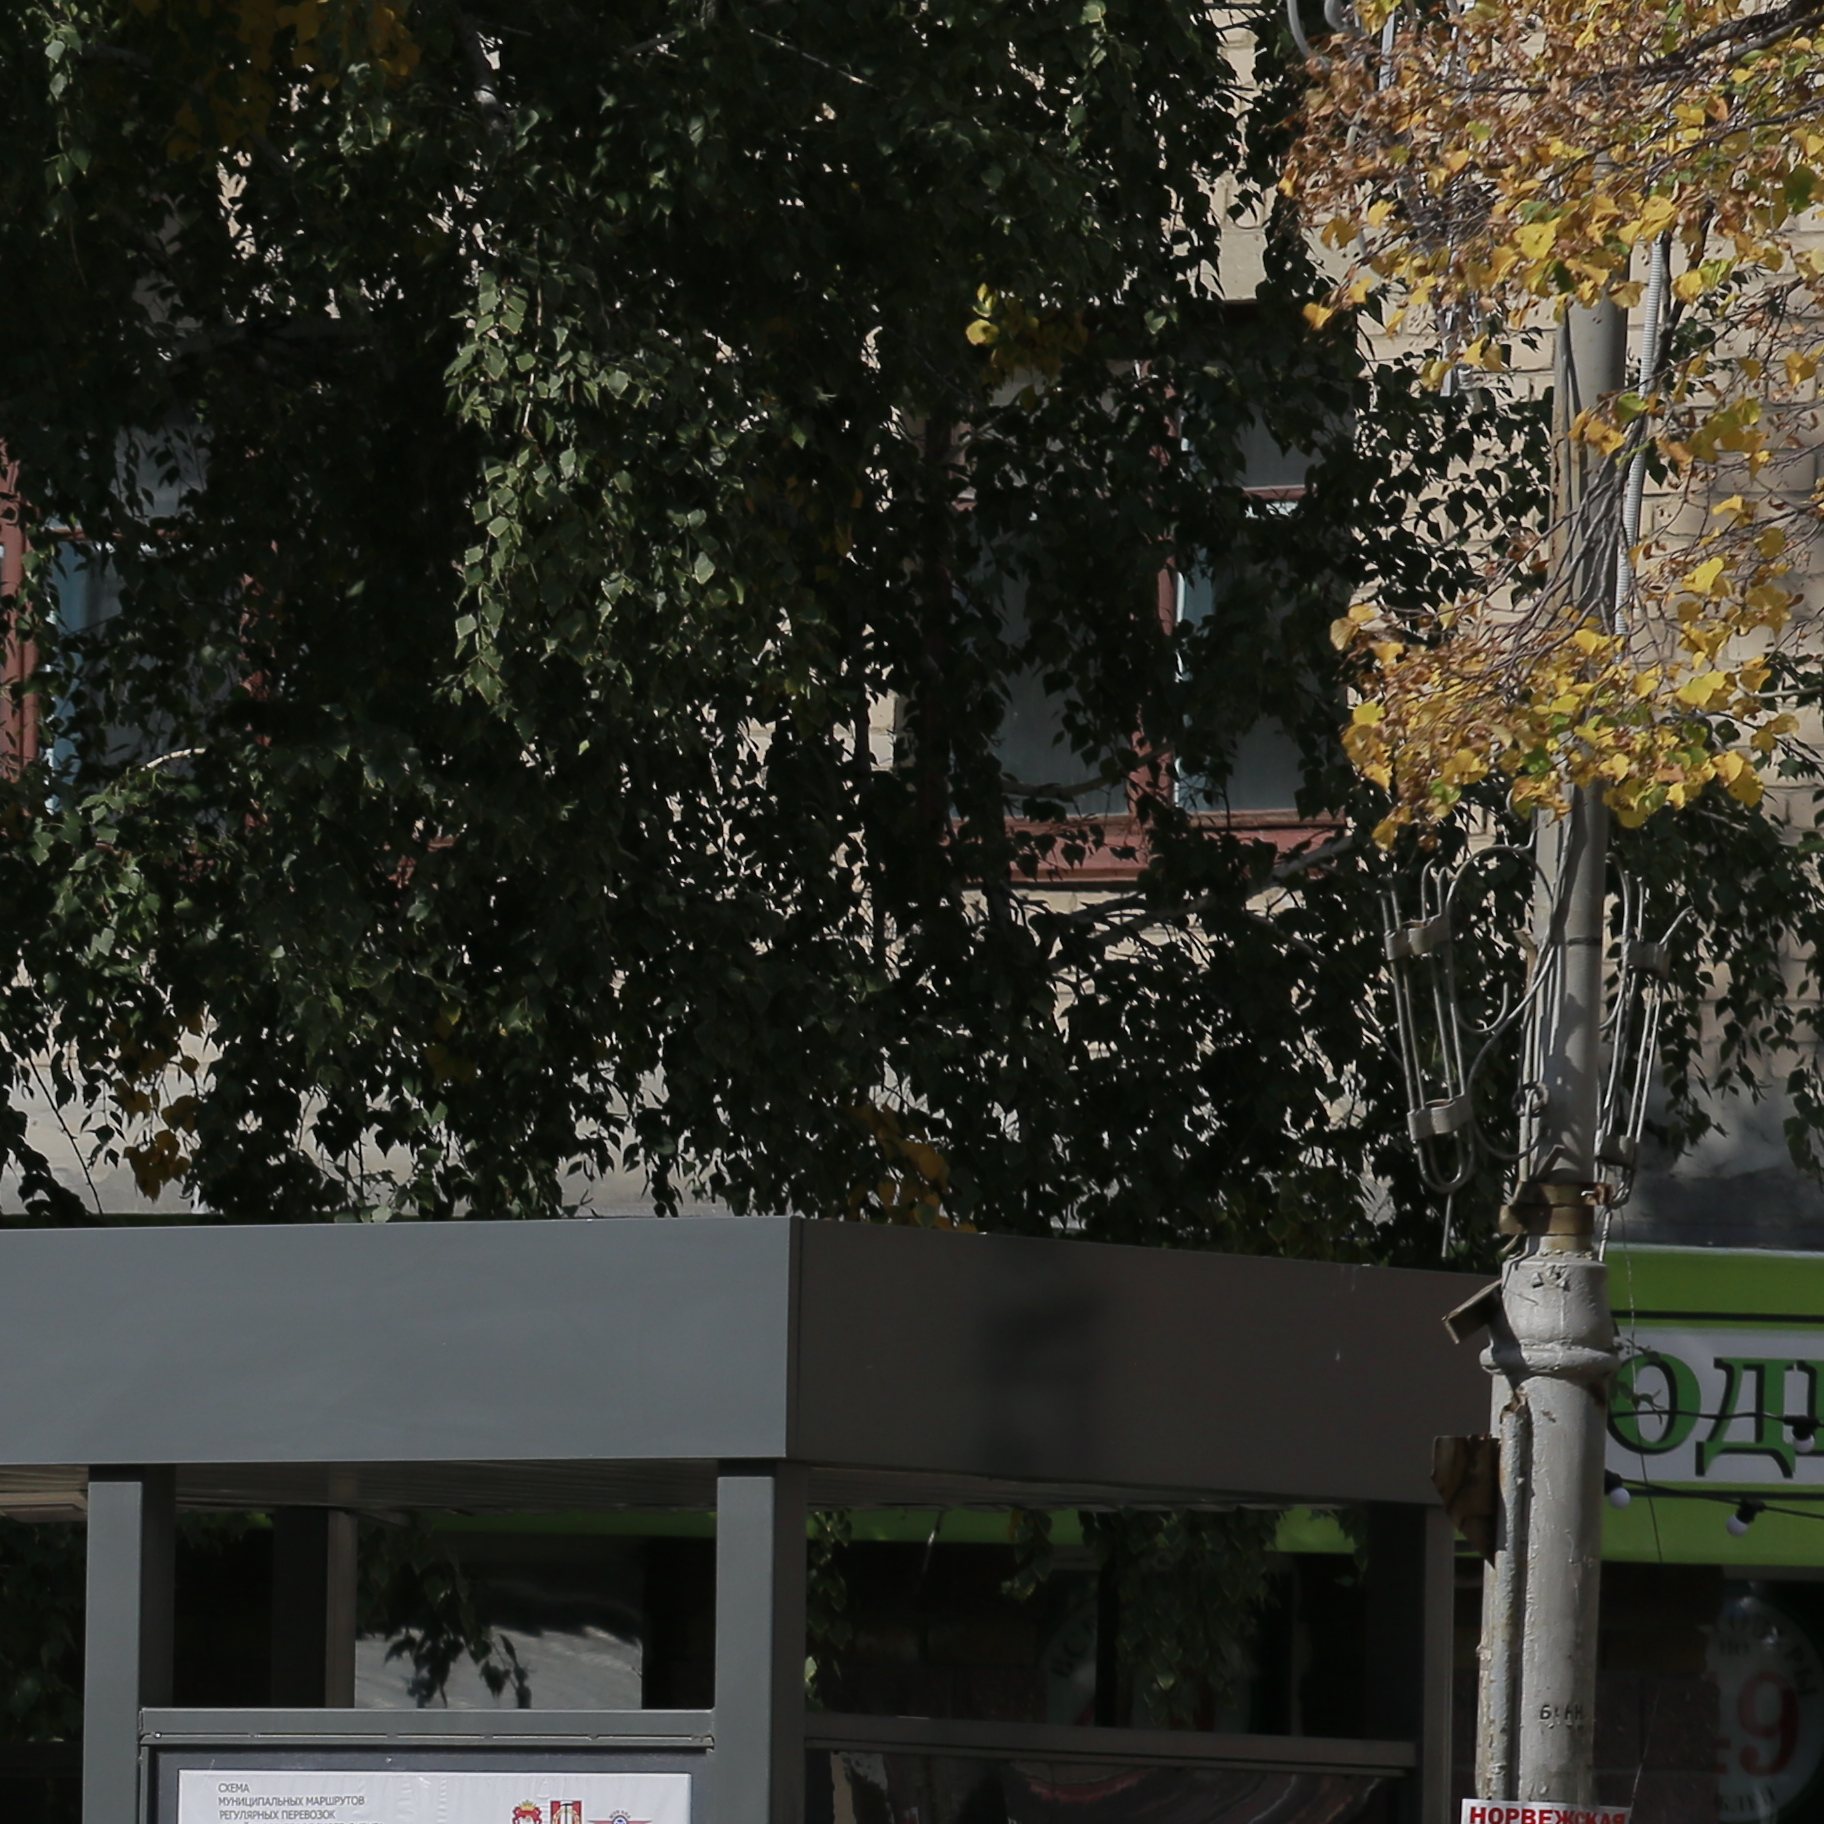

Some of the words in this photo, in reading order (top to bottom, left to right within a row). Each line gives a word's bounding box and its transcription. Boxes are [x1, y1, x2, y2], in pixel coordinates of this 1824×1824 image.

[218, 1783, 250, 1793] СХЕМА
[218, 1796, 304, 1807] МУНИЦИПАЛЬНЫХ
[306, 1796, 365, 1806] МАРШРУТОВ
[219, 1810, 278, 1820] РЕГУЛЯРНЫХ
[281, 1810, 336, 1820] ПЕРЕВОЗОК
